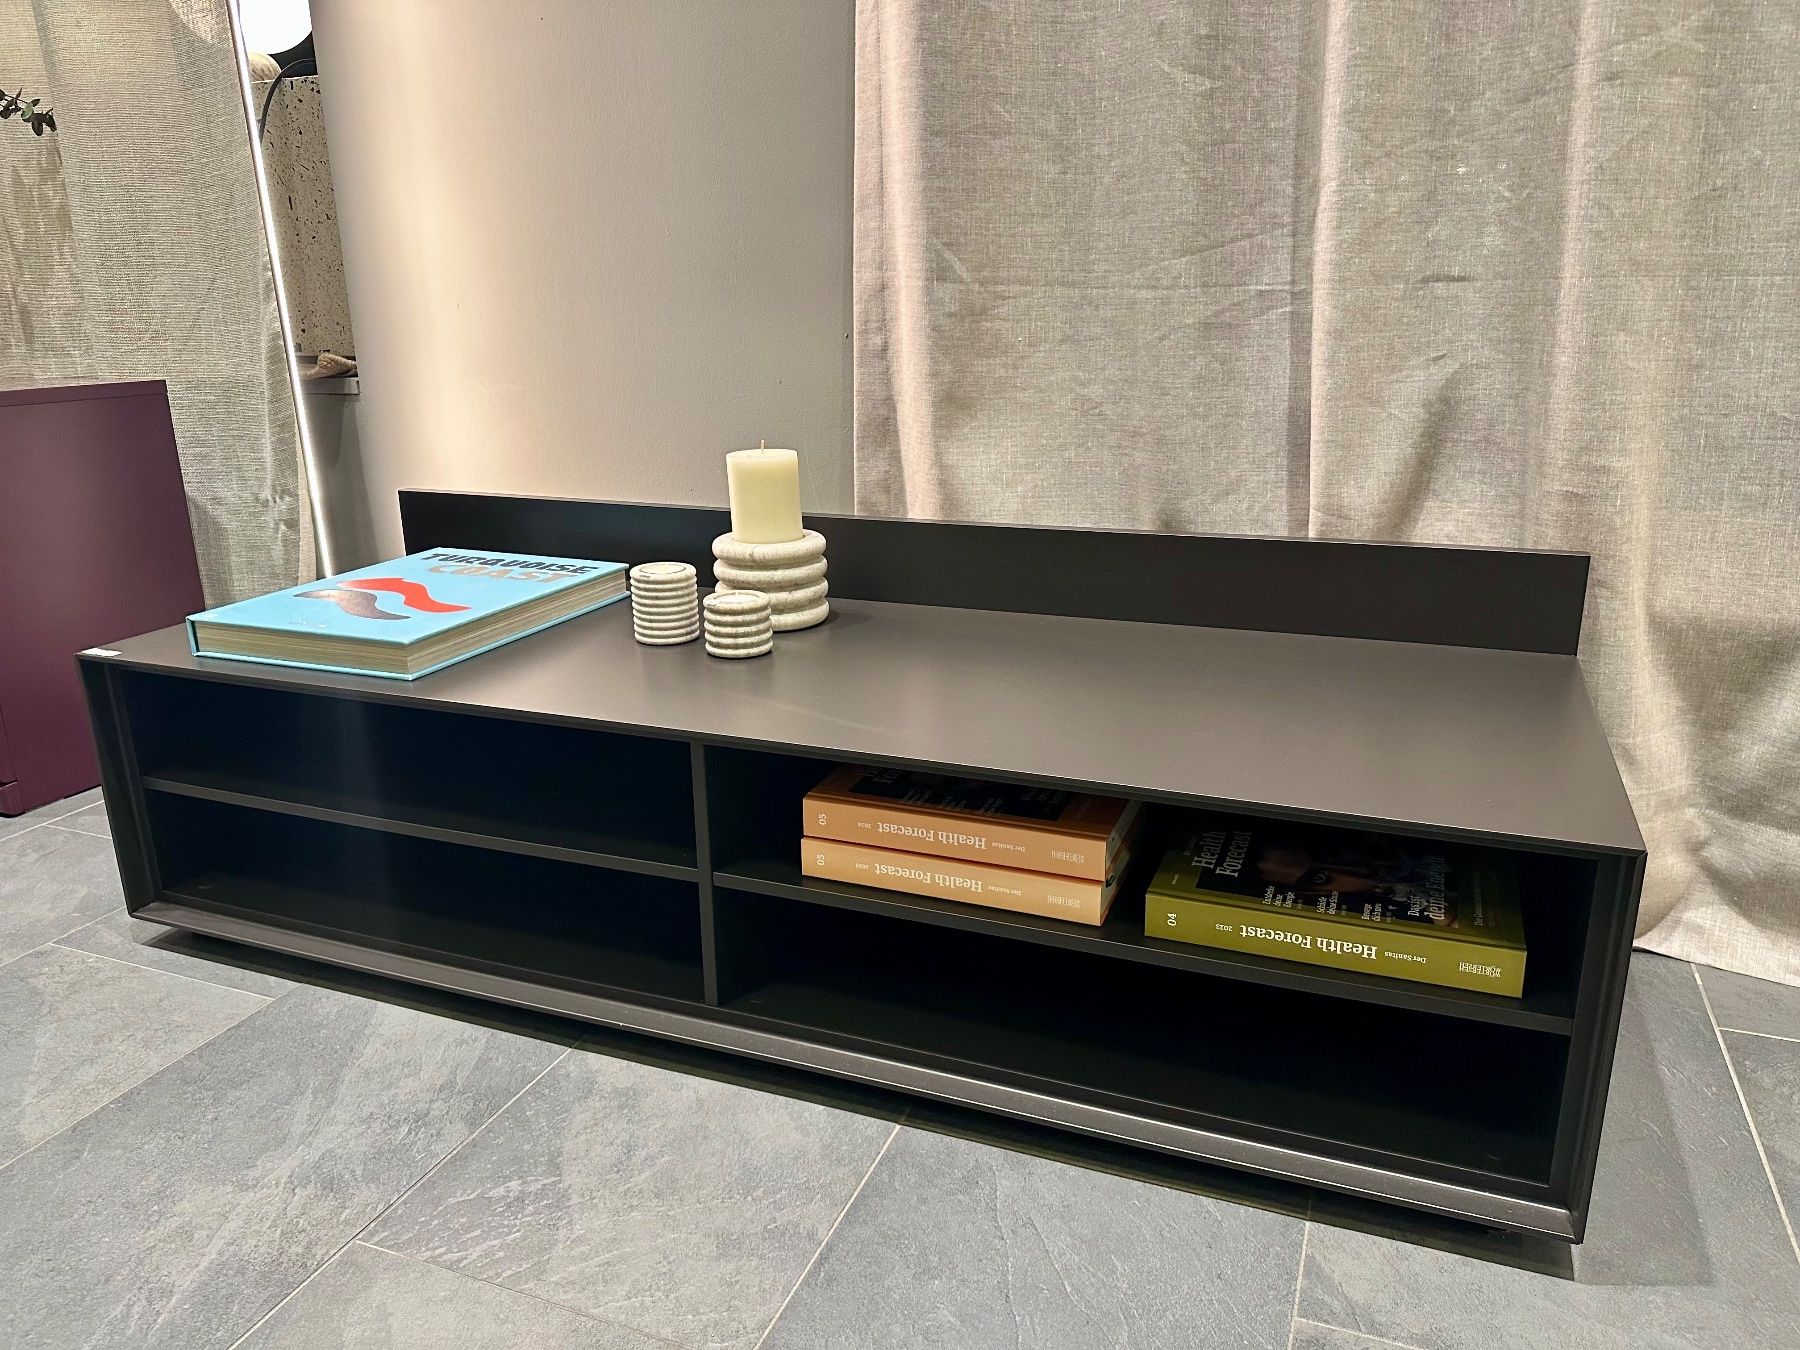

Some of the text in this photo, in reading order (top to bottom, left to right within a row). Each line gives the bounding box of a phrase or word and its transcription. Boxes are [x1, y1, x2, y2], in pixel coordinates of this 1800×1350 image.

[420, 553, 599, 574] TURQUOISE
[428, 564, 578, 583] COAST
[818, 813, 827, 826] 05
[877, 822, 935, 841] Forecast
[938, 831, 987, 850] Health
[1191, 831, 1227, 869] Health
[1215, 830, 1253, 878] Forecast
[816, 854, 825, 866] 05
[874, 863, 931, 884] Forecast
[935, 873, 983, 892] Health
[1167, 913, 1177, 926] 04
[1215, 923, 1233, 932] 2023
[1239, 924, 1312, 949] Forecast
[1316, 937, 1378, 959] Health
[1384, 951, 1412, 961] Sanitas
[1412, 956, 1427, 964] Der
